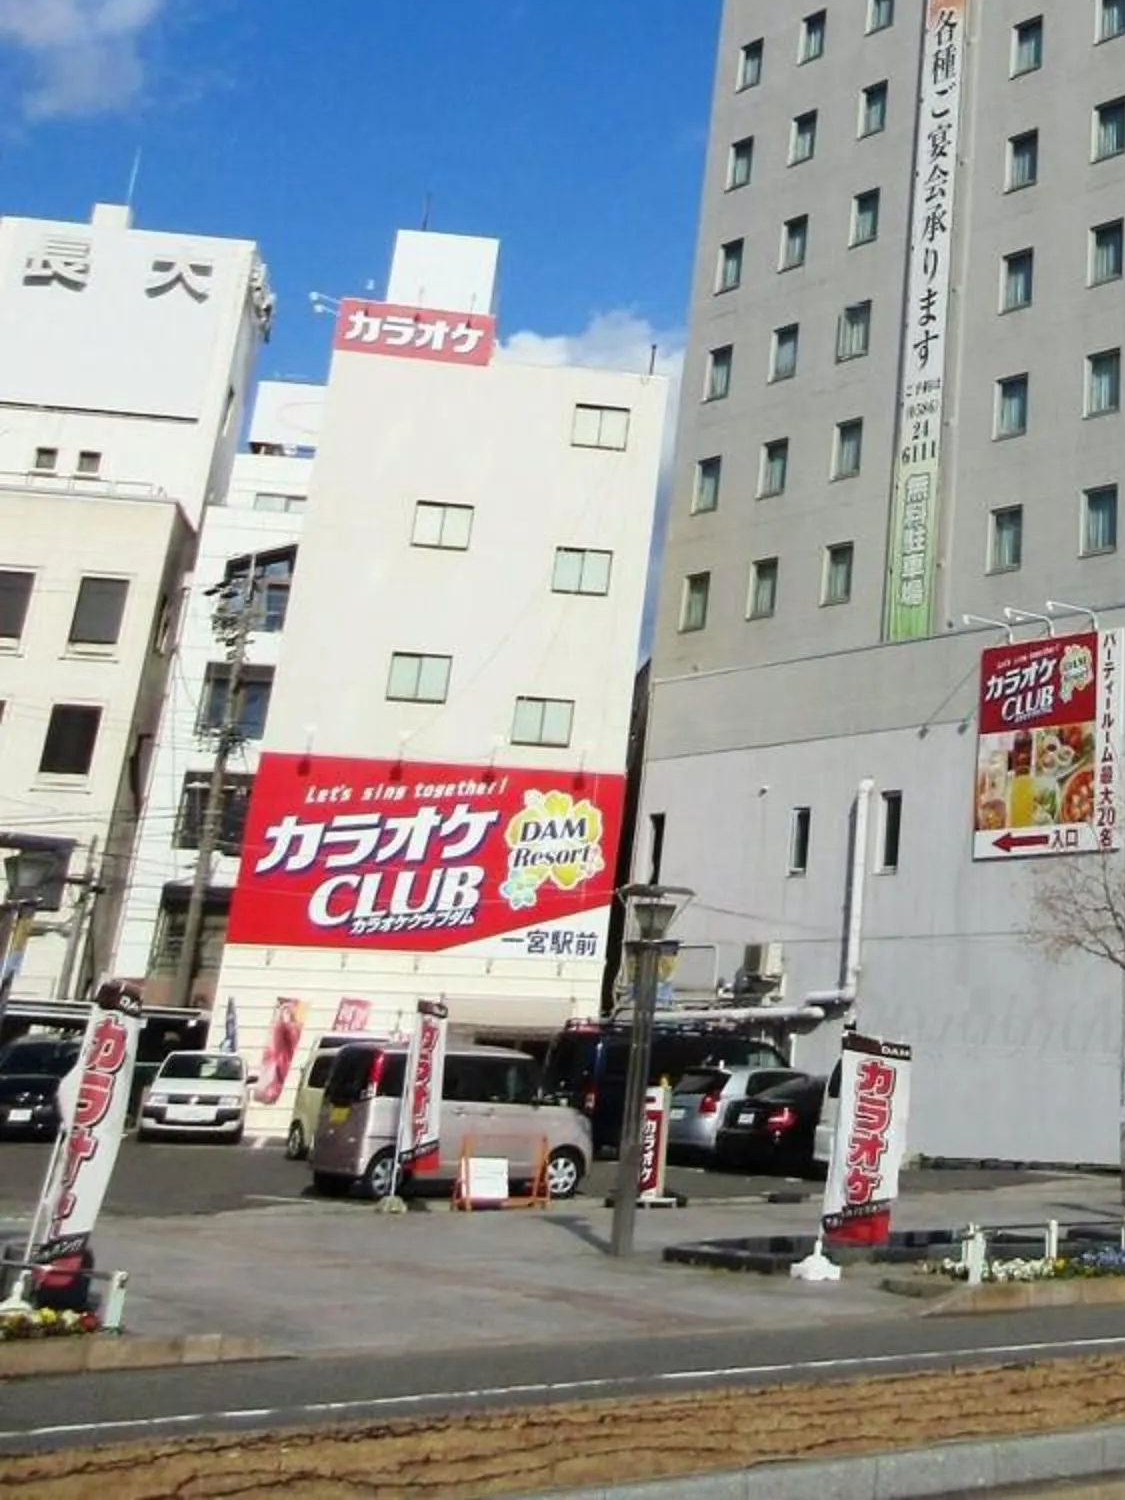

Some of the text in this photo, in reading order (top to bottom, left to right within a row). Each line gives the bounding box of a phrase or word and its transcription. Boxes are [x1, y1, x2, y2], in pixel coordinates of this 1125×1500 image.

[912, 9, 959, 372] 各種ご宴会承ります
[344, 310, 485, 354] カラオケ
[902, 440, 936, 464] 6111
[985, 657, 1057, 702] カラオケ
[1002, 684, 1055, 721] CLUB
[305, 784, 353, 803] Let's
[255, 803, 500, 876] カラオケ
[518, 816, 588, 843] DAM
[1051, 829, 1079, 849] 入口
[511, 844, 592, 869] Resort
[308, 864, 485, 927] CLUB
[500, 930, 600, 957] 一宮駅前
[846, 1059, 897, 1204] カラオケ
